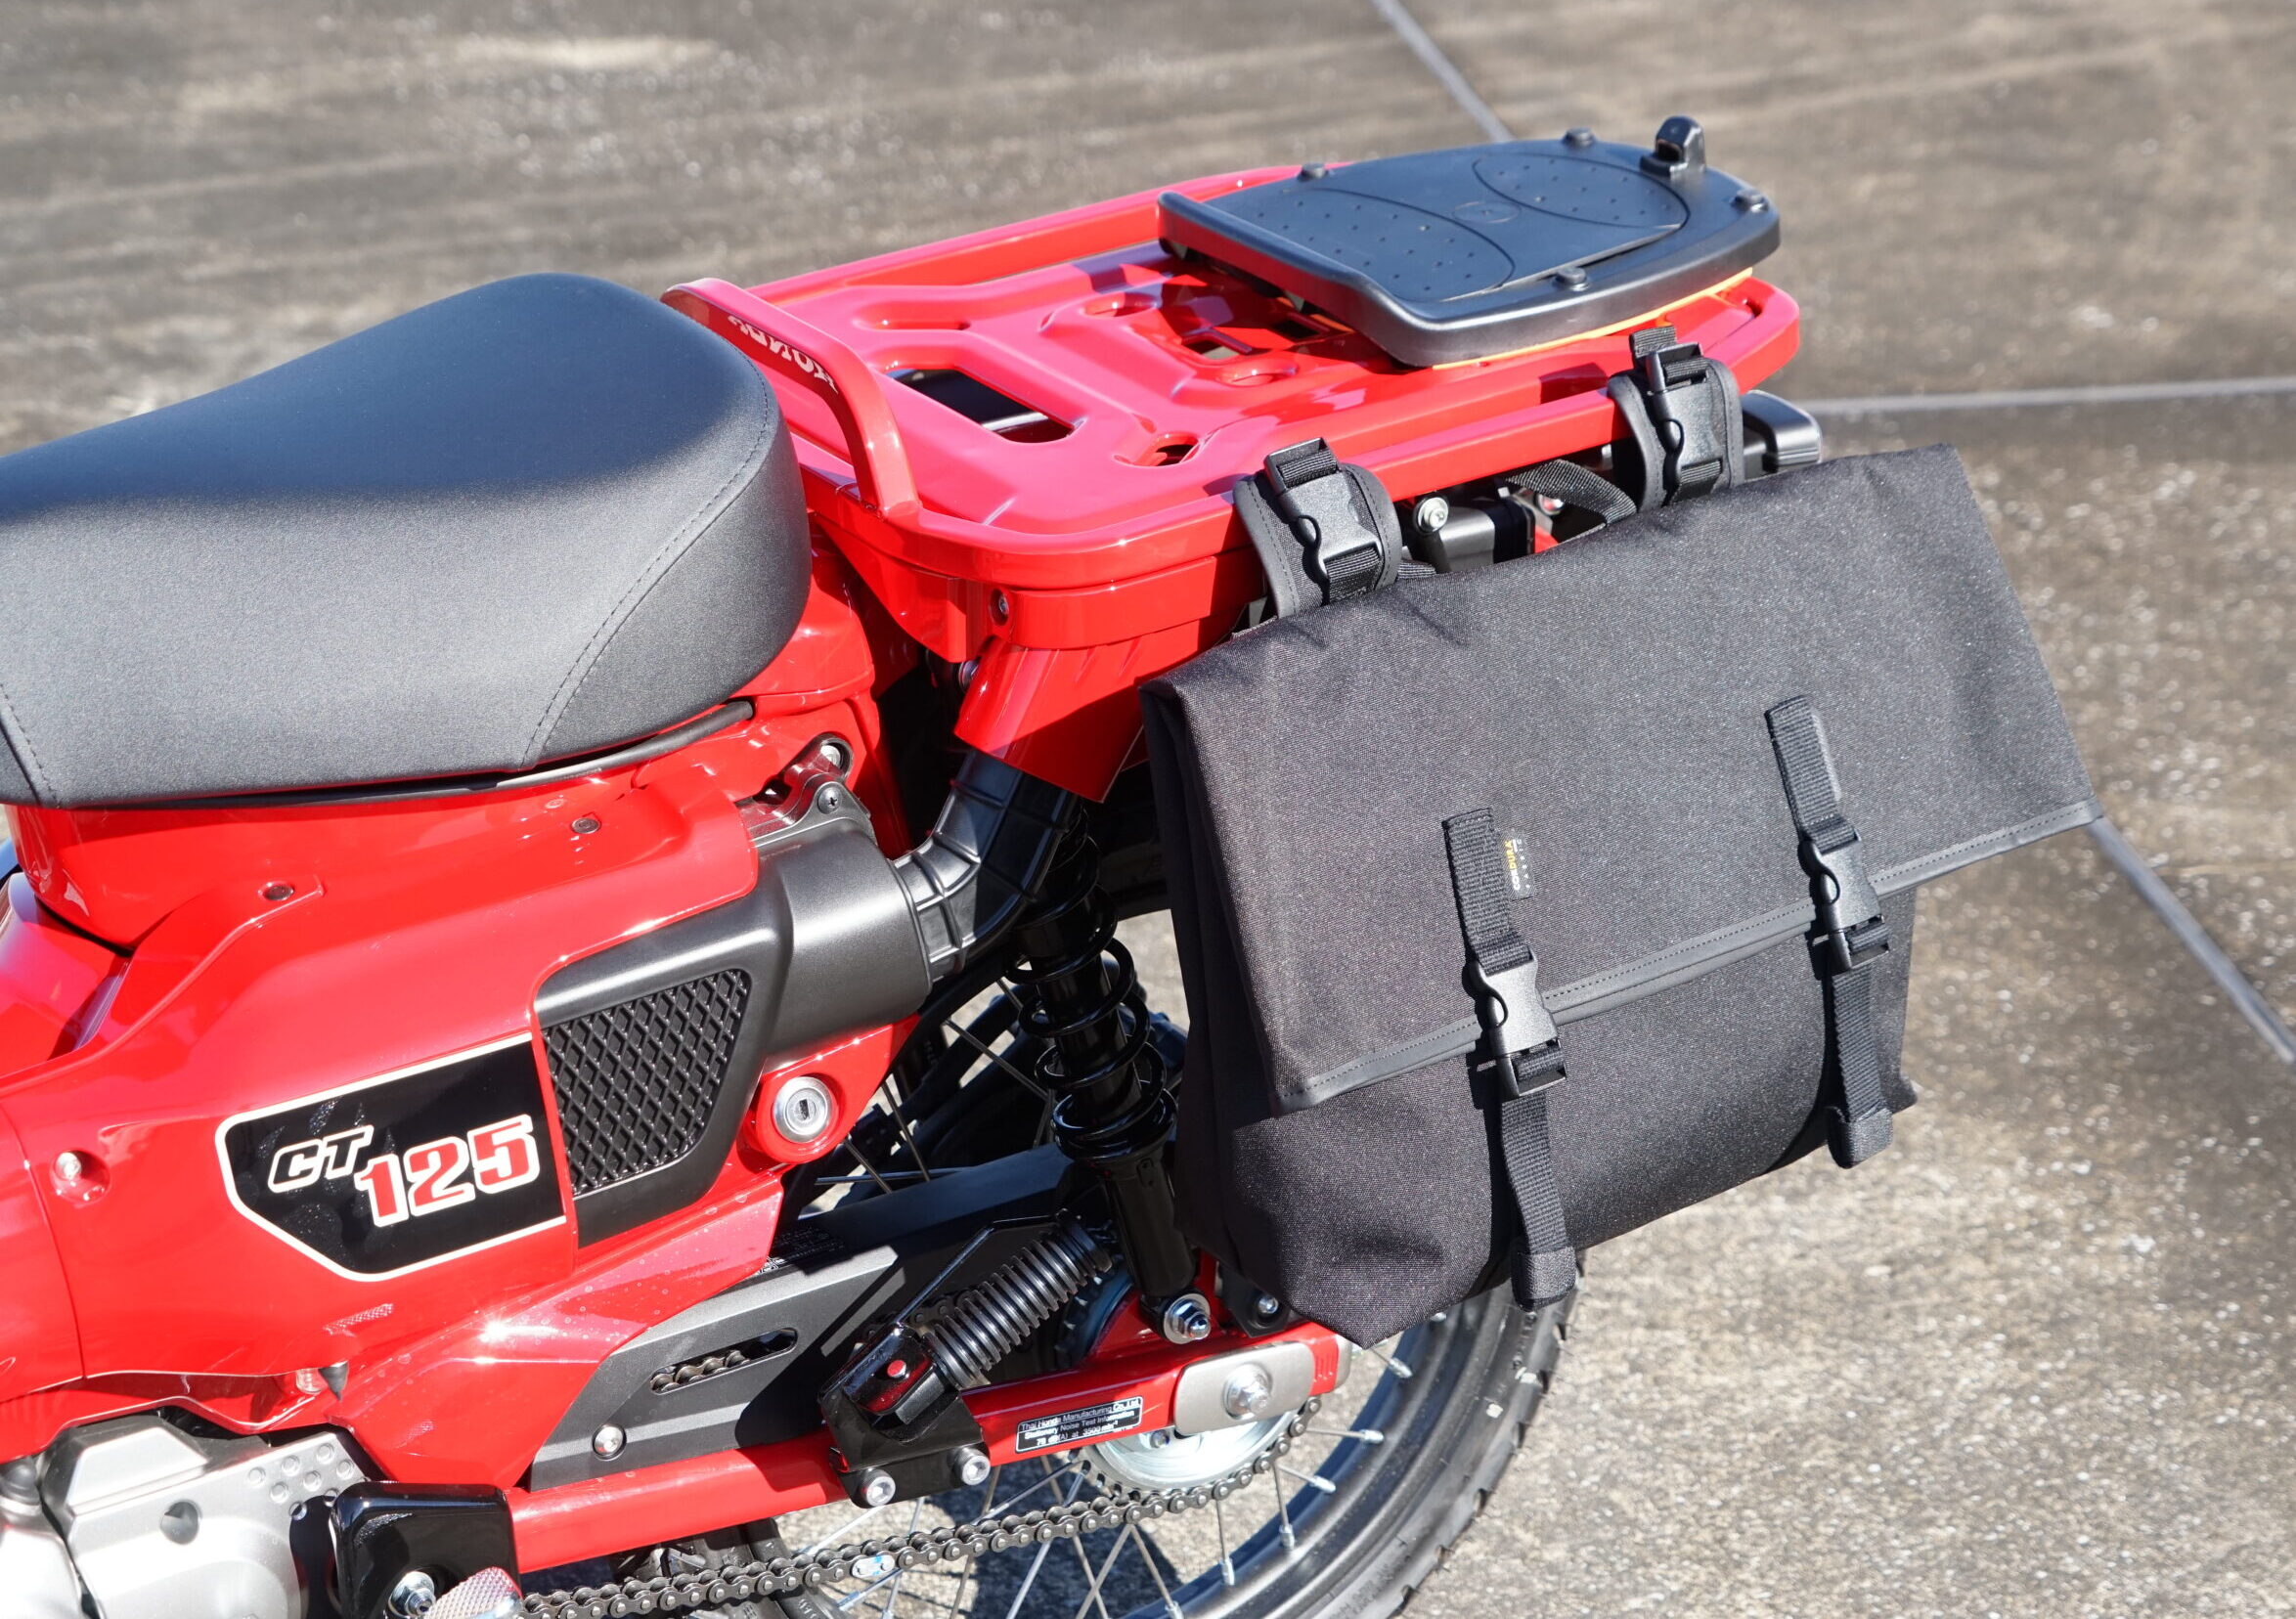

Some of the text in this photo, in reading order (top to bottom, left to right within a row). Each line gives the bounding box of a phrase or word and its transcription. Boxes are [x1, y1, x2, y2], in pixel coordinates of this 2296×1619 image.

[268, 1115, 541, 1228] CT 125
[1022, 1421, 1037, 1431] Thai
[1038, 1417, 1061, 1428] Honda
[1063, 1407, 1112, 1423] Manufacturing
[1060, 1423, 1080, 1432] Noise
[1082, 1418, 1096, 1426] Test
